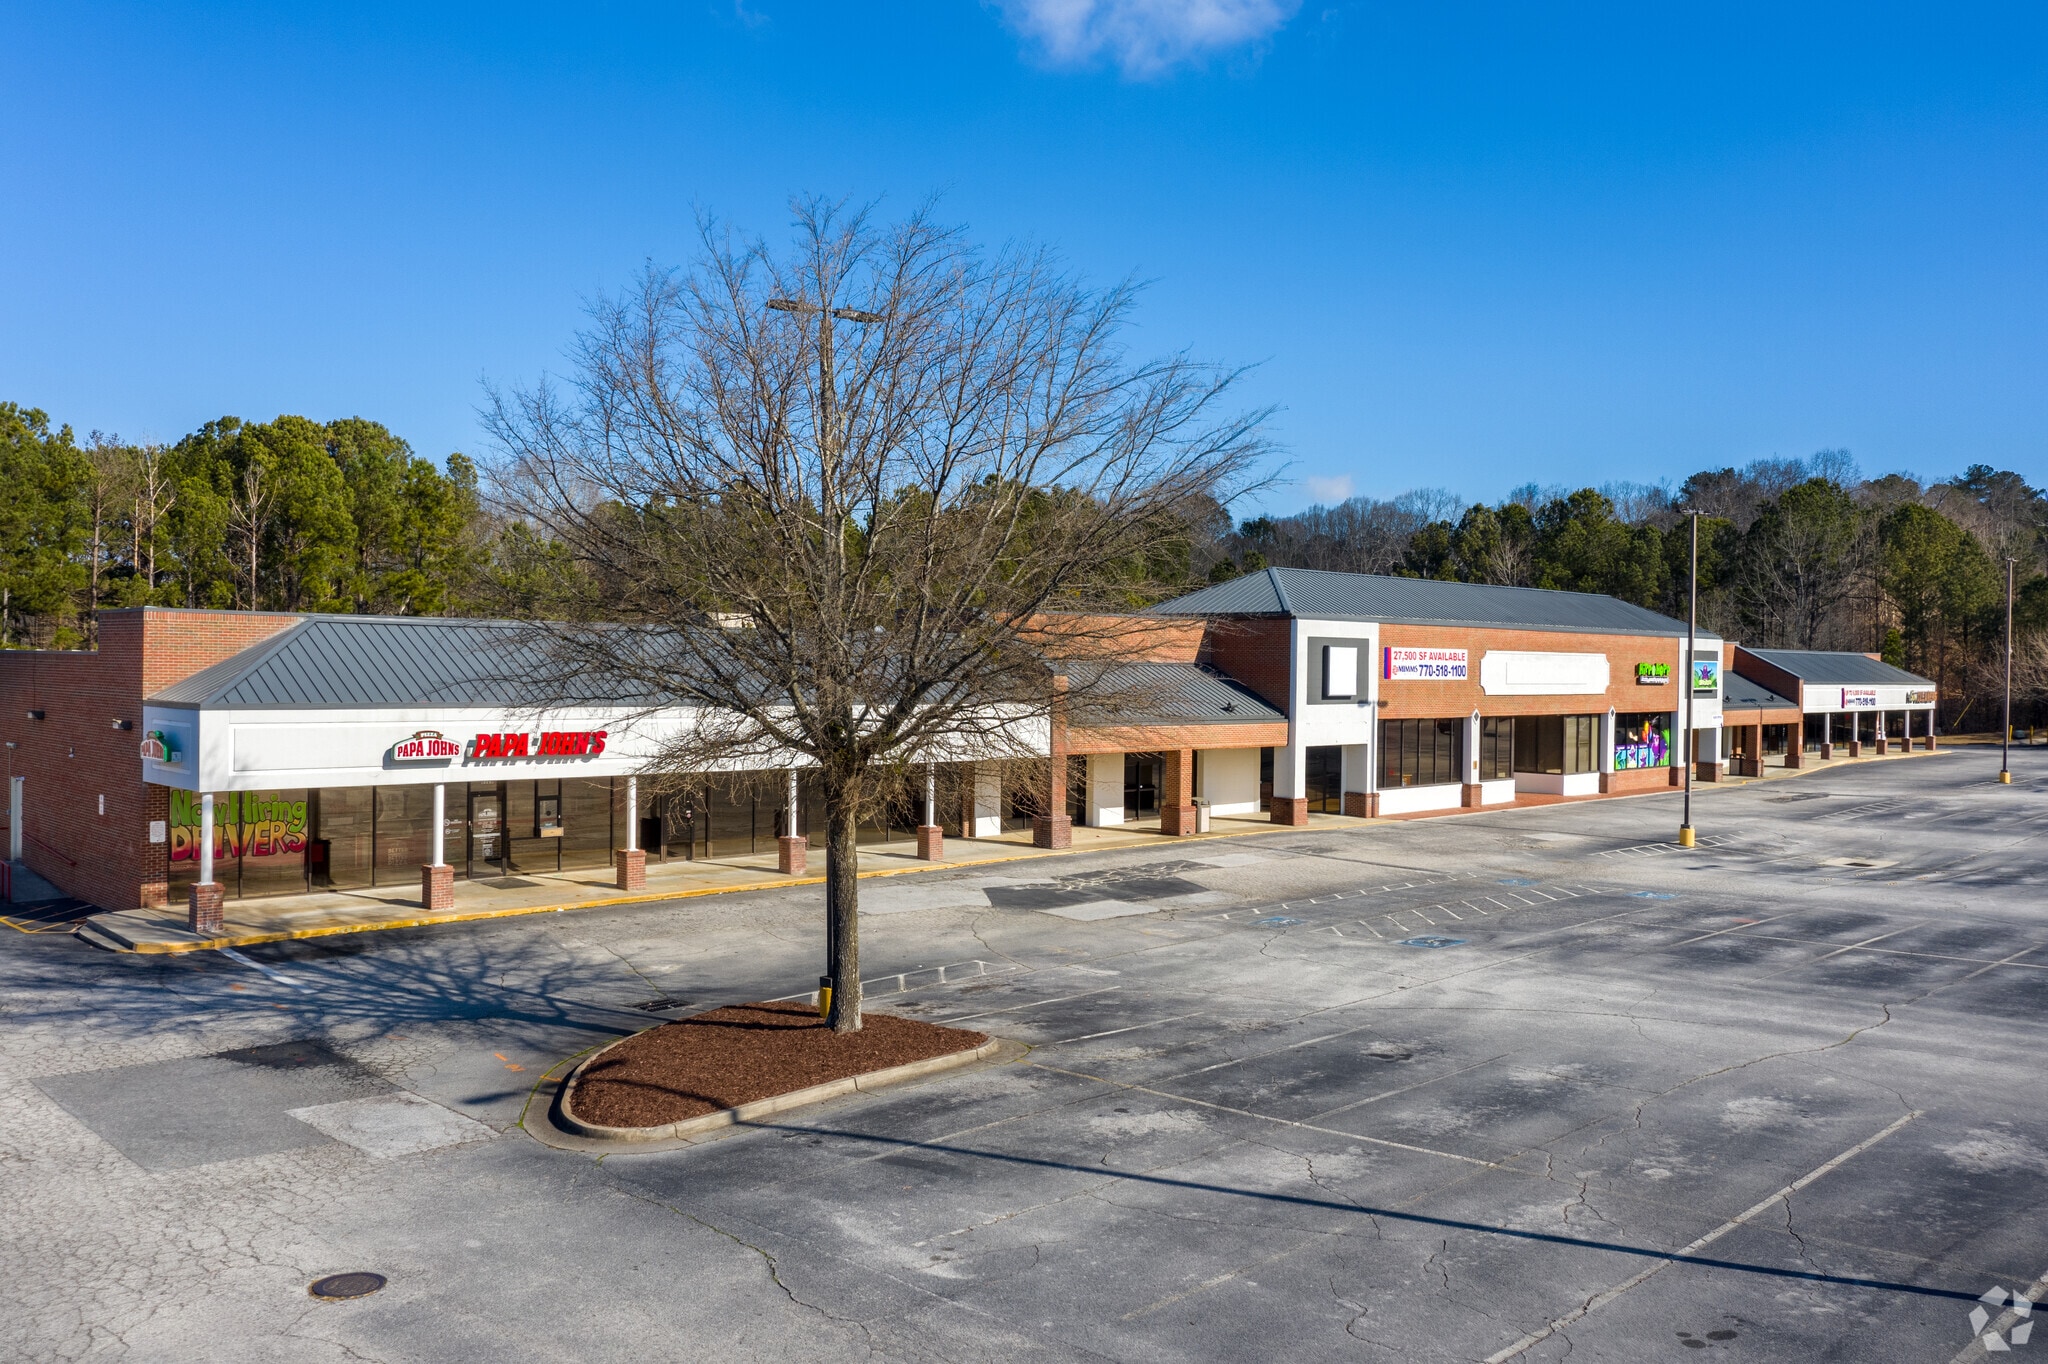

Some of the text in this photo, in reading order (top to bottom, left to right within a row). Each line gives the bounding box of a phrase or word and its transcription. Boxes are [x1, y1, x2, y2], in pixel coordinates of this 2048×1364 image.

[1393, 651, 1466, 662] 27,500 SF AVAILABLE
[397, 740, 460, 757] PAPA JOHNS
[473, 730, 608, 758] PAPA JOHN'S
[229, 791, 307, 833] Hiring
